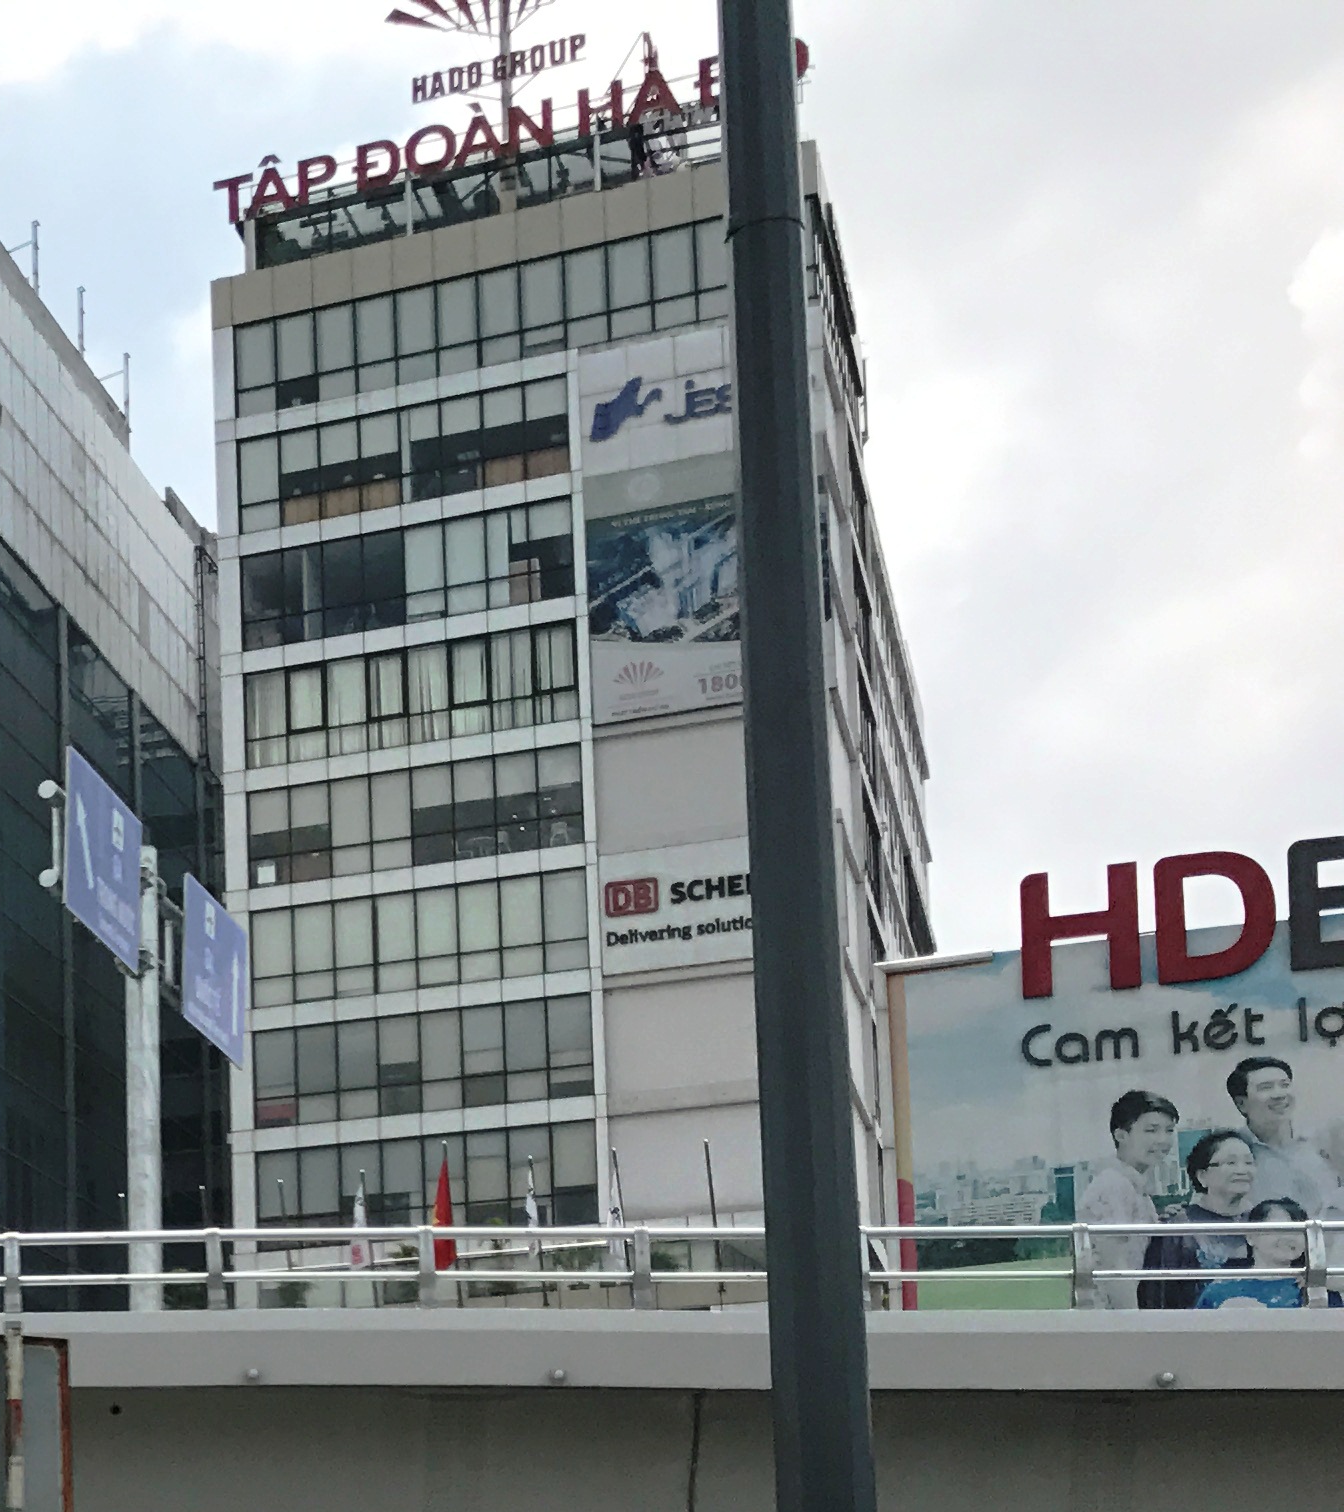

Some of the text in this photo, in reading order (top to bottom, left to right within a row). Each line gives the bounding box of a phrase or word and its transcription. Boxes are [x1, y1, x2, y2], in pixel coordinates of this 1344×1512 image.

[412, 34, 587, 103] HADO GROUP
[356, 100, 553, 191] ĐOÀN
[611, 881, 654, 913] DB
[607, 916, 752, 947] Delivering solutio
[1021, 1023, 1139, 1067] Cam
[1171, 1003, 1265, 1056] kết
